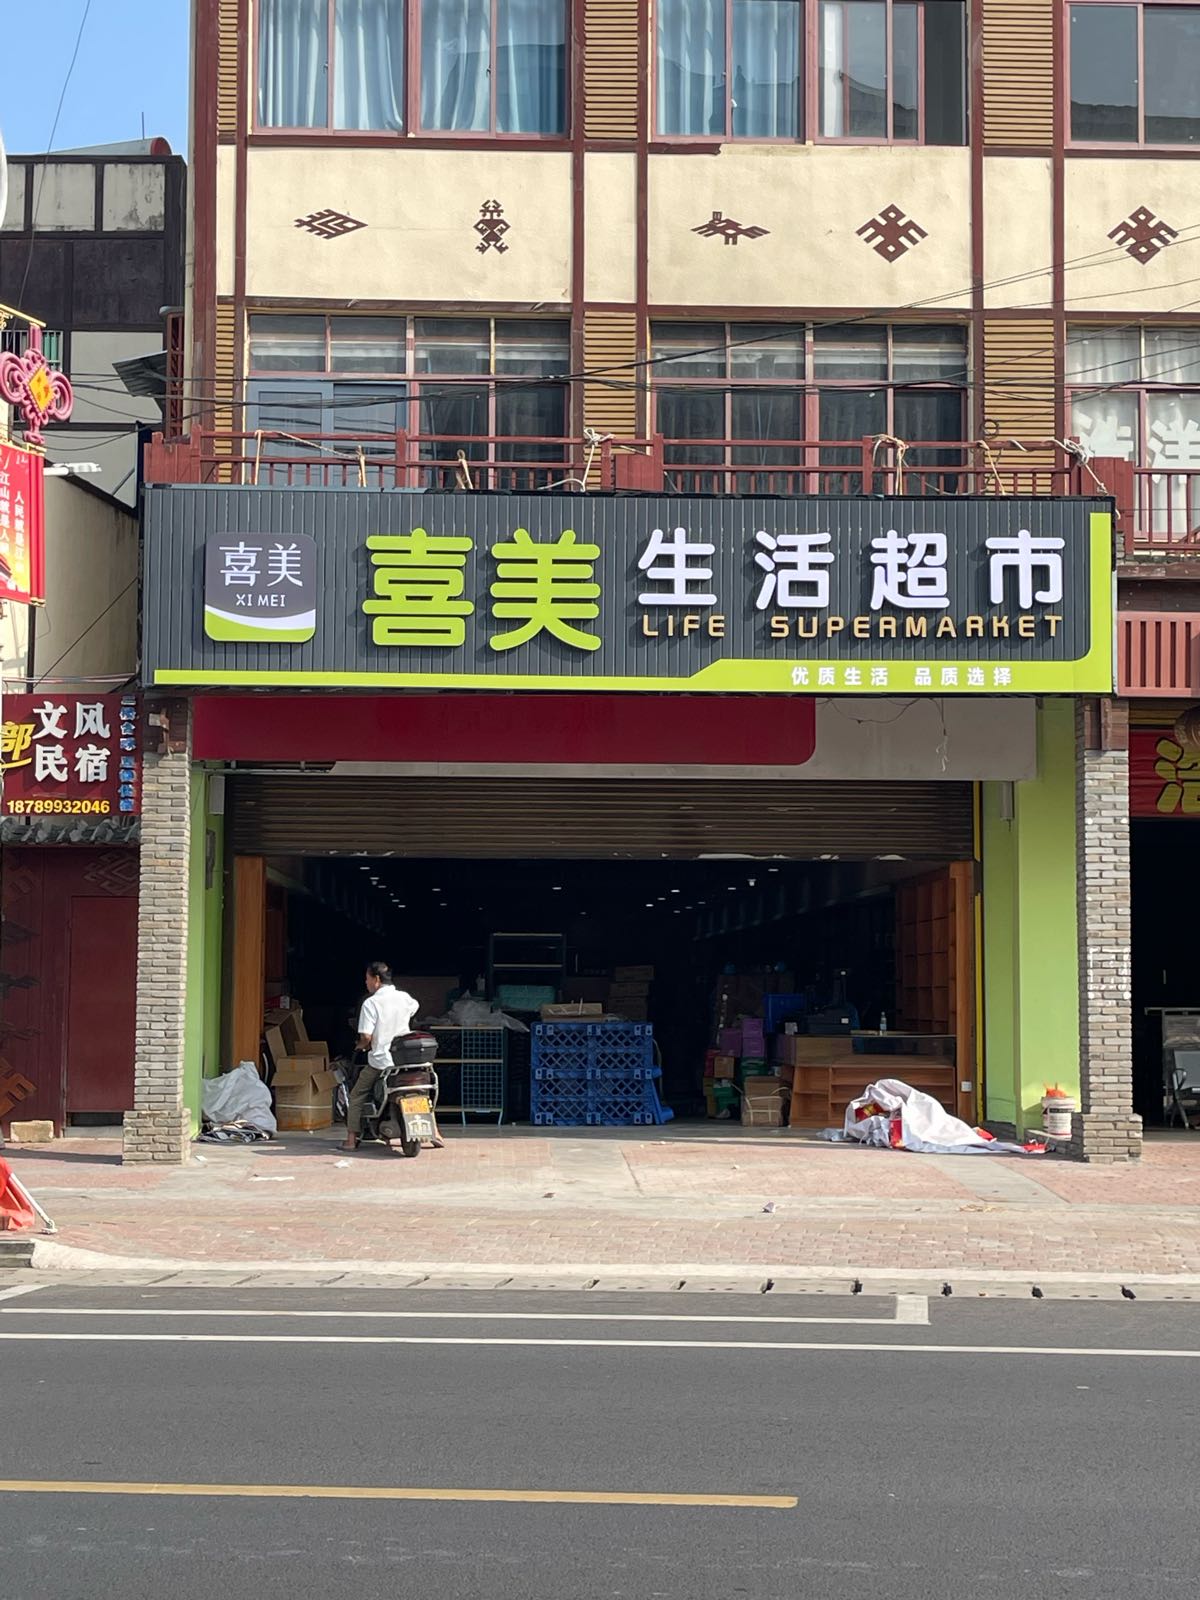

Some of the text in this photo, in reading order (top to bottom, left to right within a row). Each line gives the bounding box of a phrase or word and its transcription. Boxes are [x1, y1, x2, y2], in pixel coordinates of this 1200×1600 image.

[219, 541, 304, 588] 喜美
[235, 593, 286, 608] XI MEI
[362, 527, 1066, 652] 喜美 生活超市
[642, 614, 1063, 639] LIFE SUPERMARKET
[791, 666, 1013, 687] 优质生活 品质选择
[32, 701, 111, 739] 文风
[35, 744, 111, 782] 民宿
[7, 800, 110, 814] 18789932046
